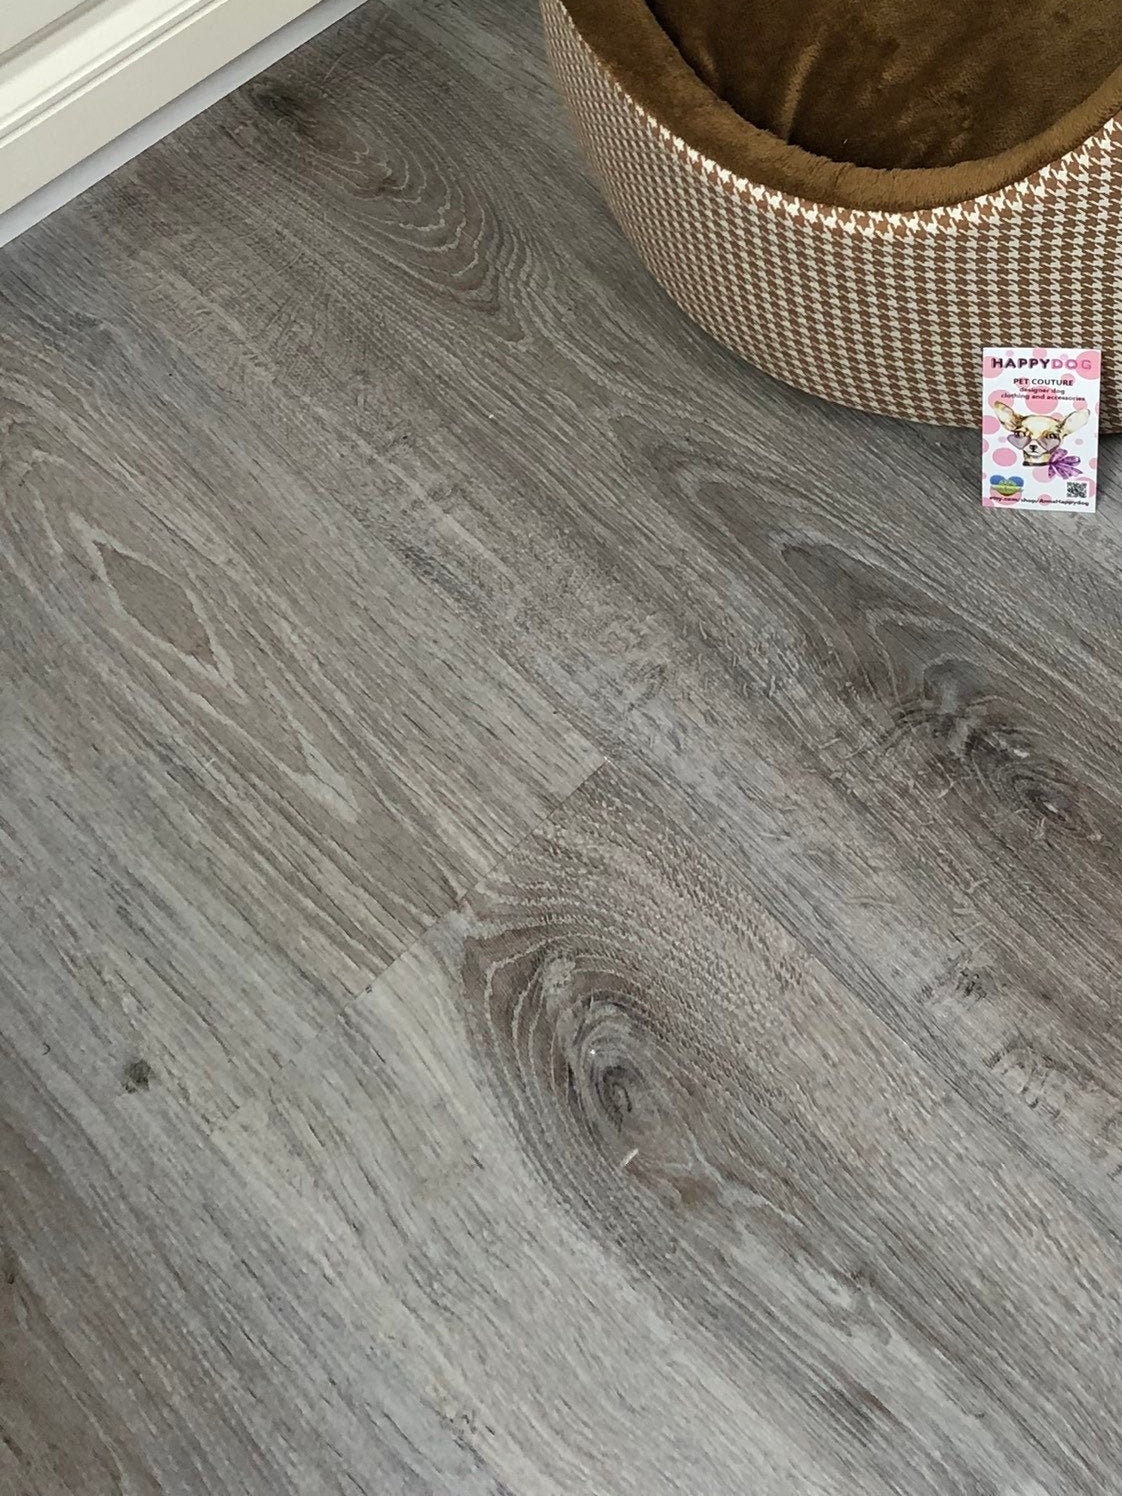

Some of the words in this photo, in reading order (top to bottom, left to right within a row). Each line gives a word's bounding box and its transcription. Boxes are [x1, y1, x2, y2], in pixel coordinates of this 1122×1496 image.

[992, 358, 1092, 370] HAPPYDOG
[1031, 378, 1074, 386] COUTURE
[1001, 392, 1030, 400] clothing
